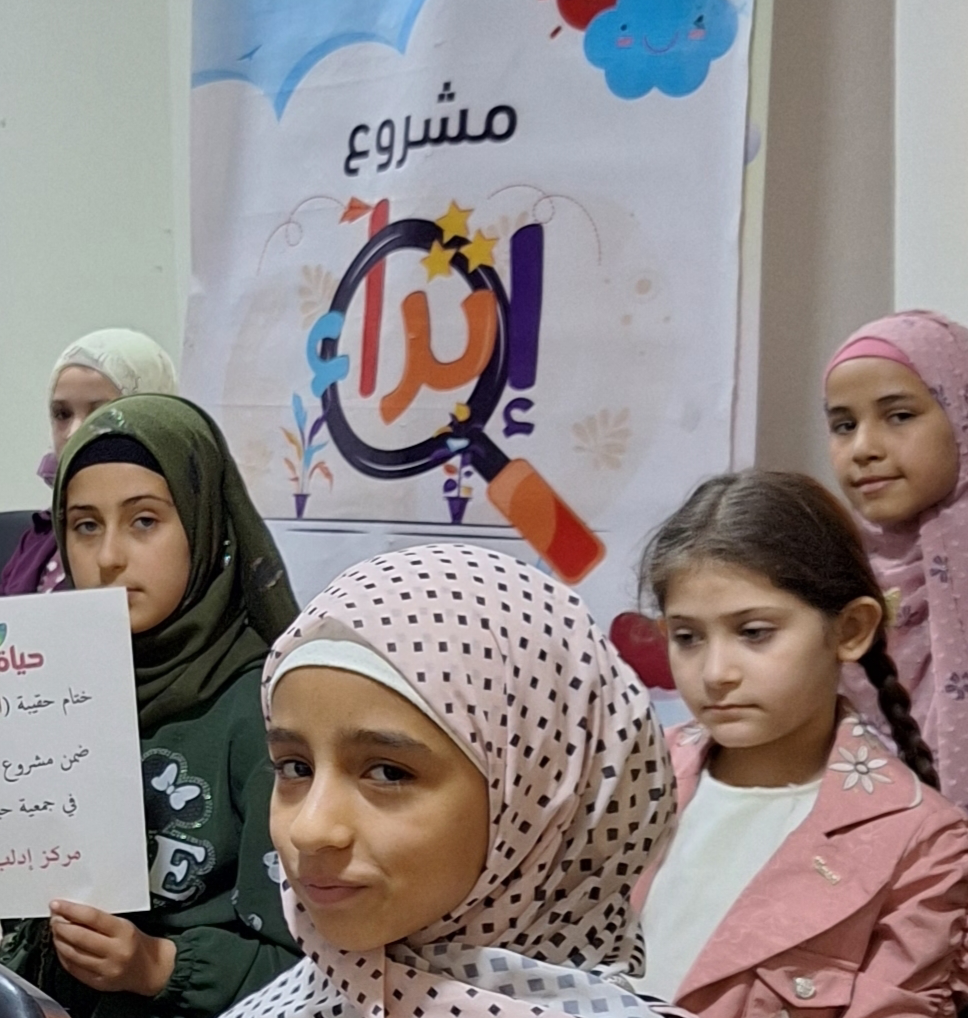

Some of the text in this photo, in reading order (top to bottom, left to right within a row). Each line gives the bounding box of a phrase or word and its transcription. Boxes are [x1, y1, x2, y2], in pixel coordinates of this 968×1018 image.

[344, 81, 518, 177] مشروع
[17, 694, 55, 714] حقيبة
[62, 687, 92, 716] ختام
[2, 754, 54, 783] مشروع
[61, 745, 90, 771] ضمن
[19, 798, 55, 817] جمعية
[62, 793, 77, 817] في
[40, 845, 81, 869] مركز
